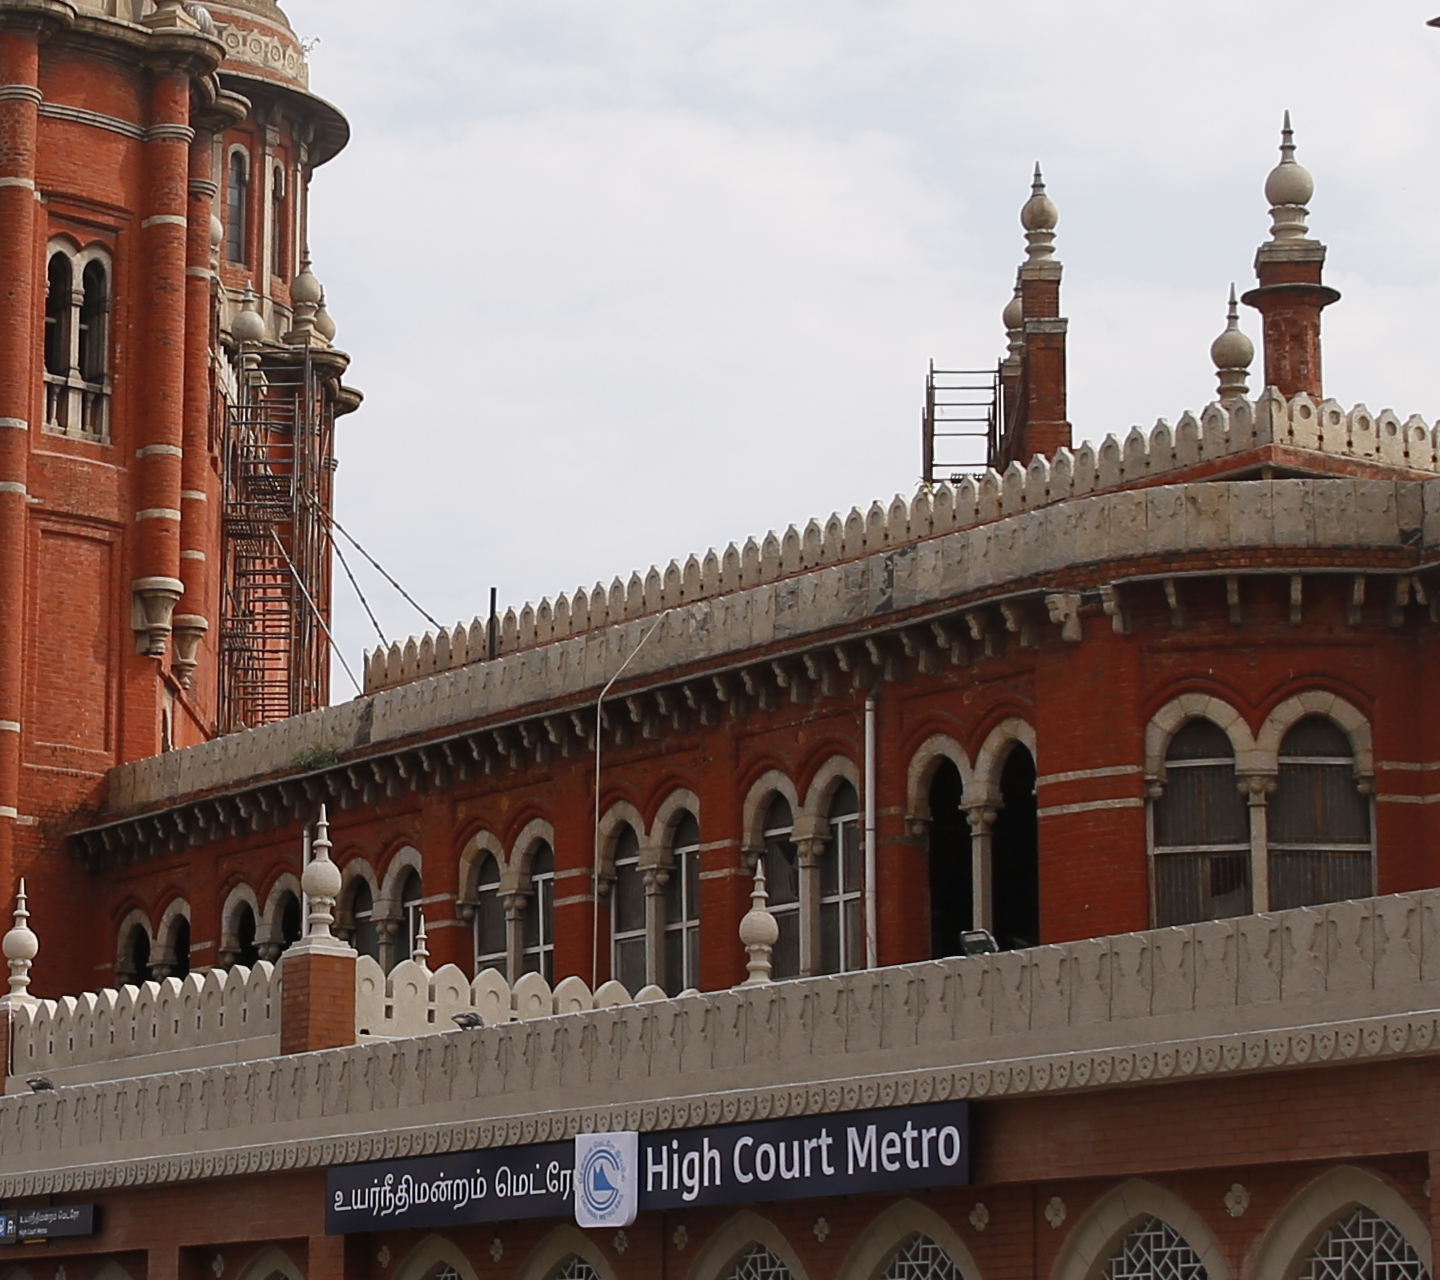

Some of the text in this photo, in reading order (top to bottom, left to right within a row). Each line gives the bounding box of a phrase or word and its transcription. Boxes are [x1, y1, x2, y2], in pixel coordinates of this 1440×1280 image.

[334, 1168, 487, 1217] உயர்நீதிமன்றம்
[646, 1121, 961, 1201] High Court Metro
